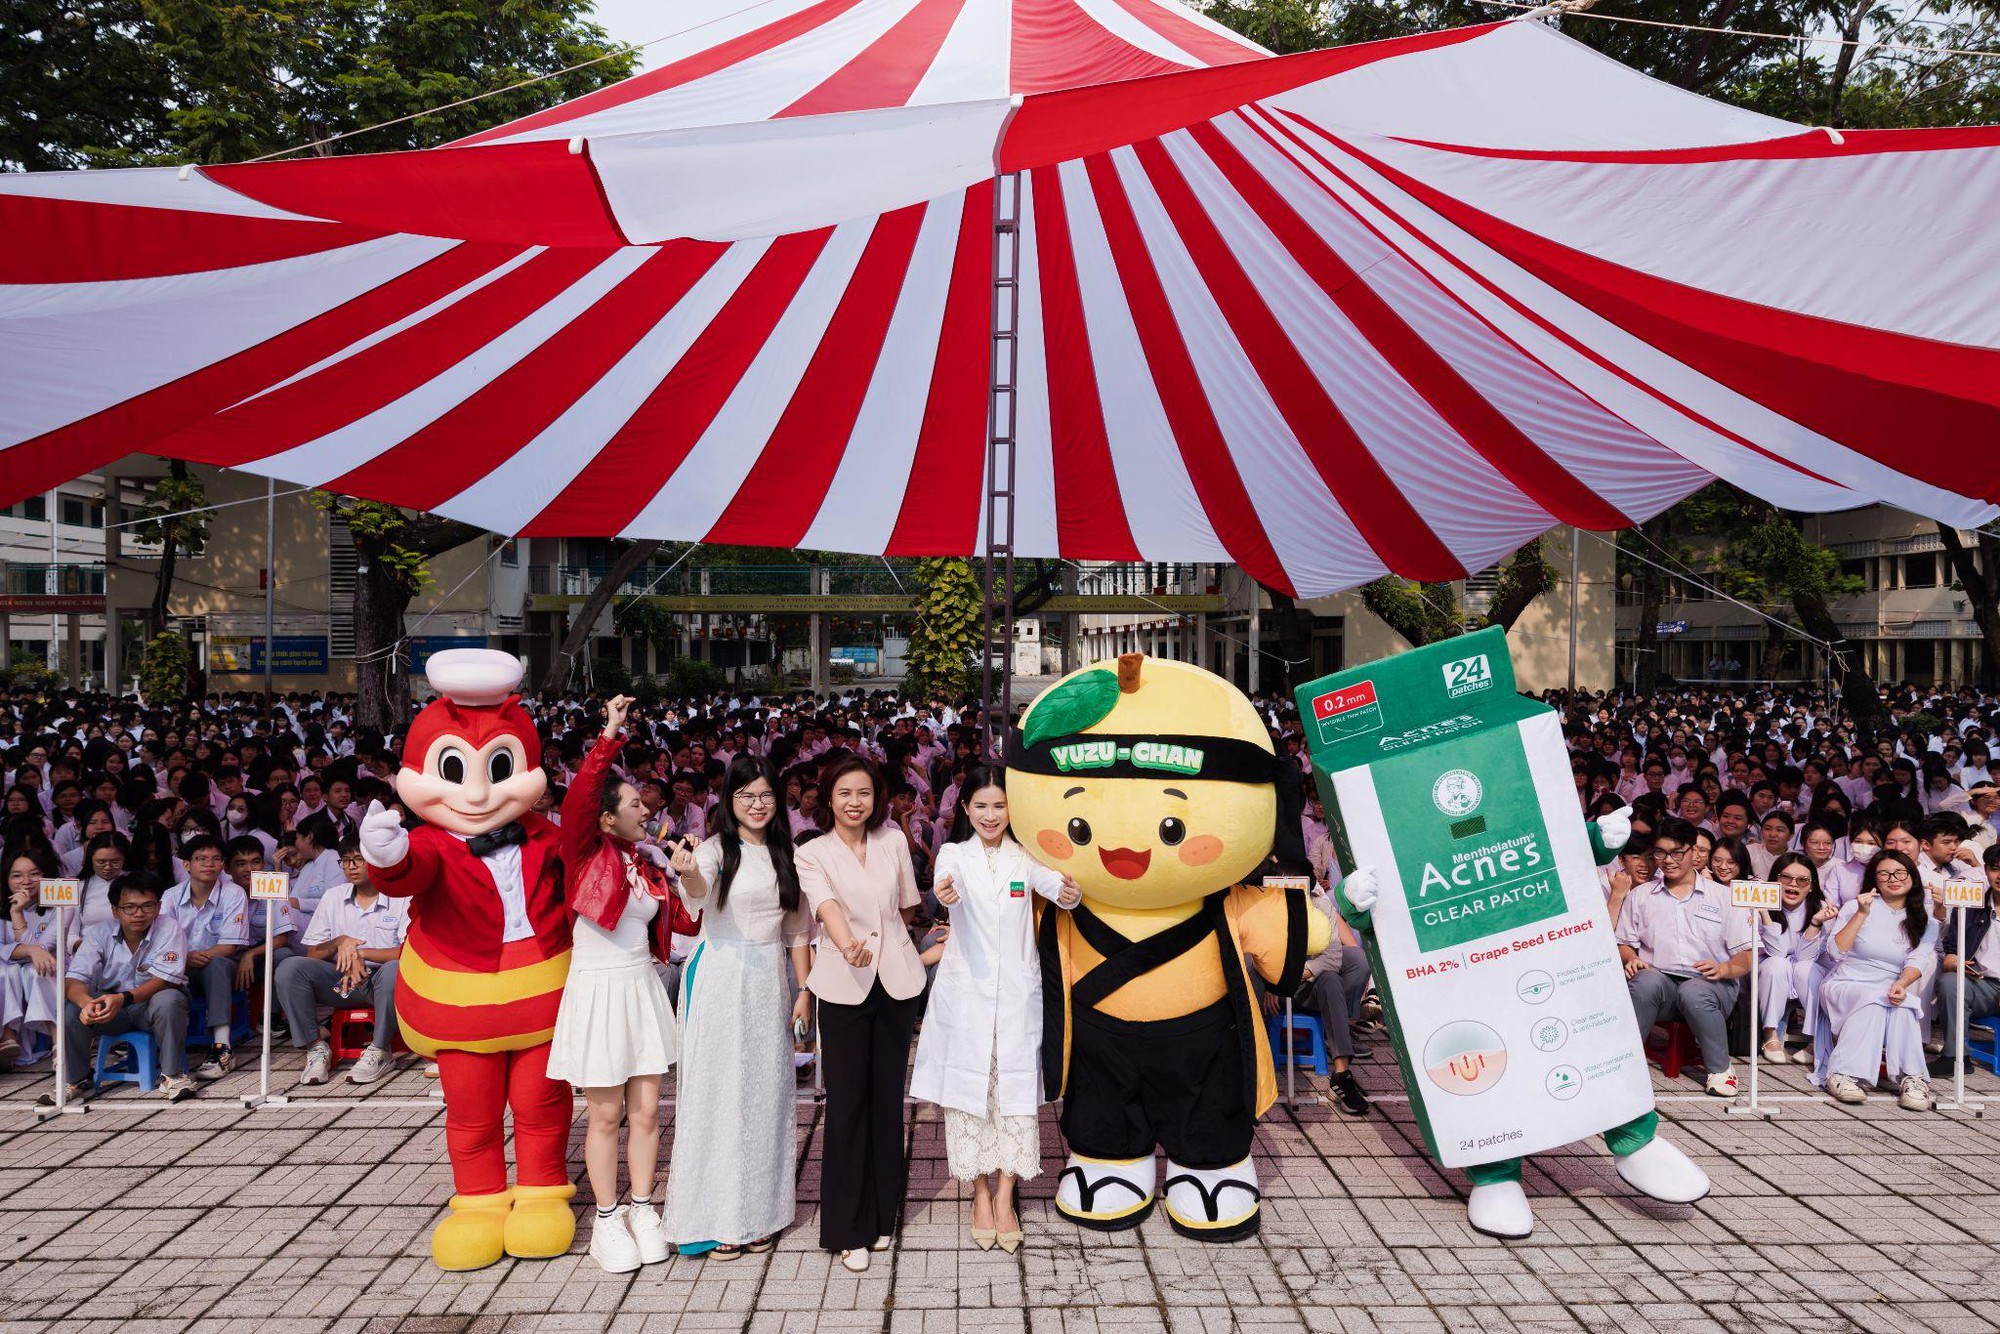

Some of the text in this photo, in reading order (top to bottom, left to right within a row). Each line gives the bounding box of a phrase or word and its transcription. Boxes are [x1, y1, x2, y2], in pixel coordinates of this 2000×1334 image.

[1450, 657, 1484, 687] 24
[1451, 679, 1490, 697] patches
[1323, 693, 1366, 712] 0.2 mm
[1359, 707, 1377, 716] PATCH
[1419, 842, 1541, 897] Acnes
[44, 884, 73, 901] 11A6
[256, 878, 282, 893] 11A7
[1947, 884, 1981, 901] 11A16
[1424, 880, 1550, 926] CLEAR PATCH
[1406, 919, 1594, 979] BHA 2% Grape Seed Extract
[1459, 1128, 1524, 1151] 24 patches
